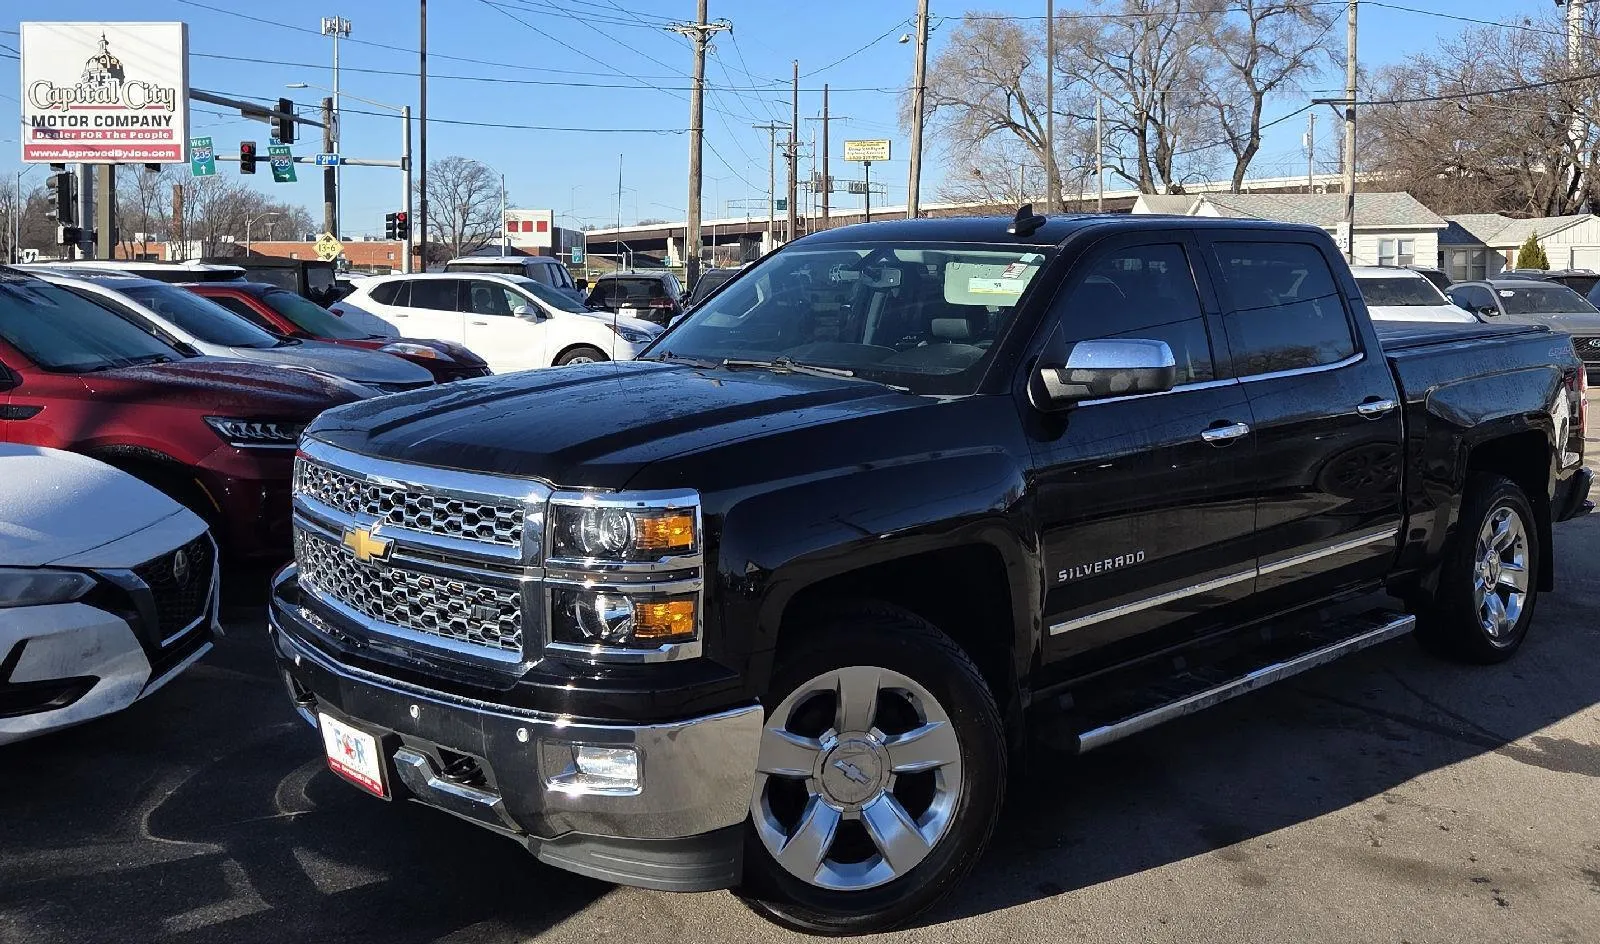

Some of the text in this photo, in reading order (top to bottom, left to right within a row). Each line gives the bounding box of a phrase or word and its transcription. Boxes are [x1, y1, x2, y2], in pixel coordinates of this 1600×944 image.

[28, 80, 176, 112] Capital City
[31, 115, 172, 127] MOTOR COMPANY
[36, 131, 76, 139] Dealer
[80, 131, 102, 139] FOR
[106, 131, 126, 139] The
[191, 139, 210, 147] WEST
[30, 149, 175, 158] www.ApprovedByJoe.com
[194, 150, 211, 159] 235
[274, 159, 291, 167] 235
[1058, 550, 1145, 582] SILVERADO
